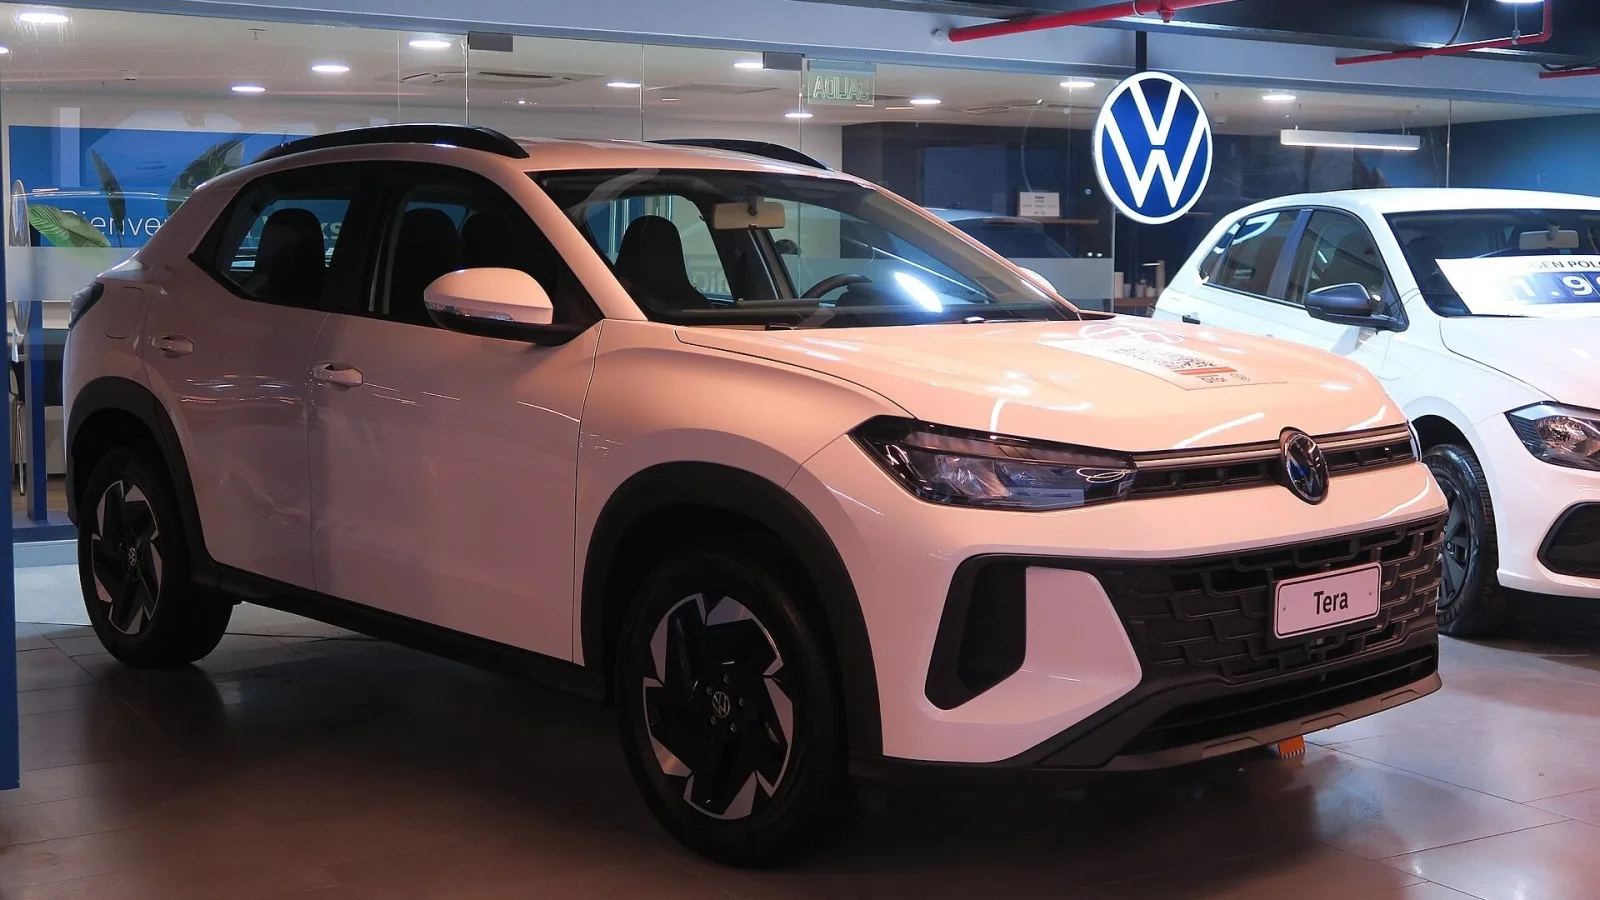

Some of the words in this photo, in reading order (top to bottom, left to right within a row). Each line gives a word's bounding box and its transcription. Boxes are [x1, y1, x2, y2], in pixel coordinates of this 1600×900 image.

[1098, 76, 1210, 214] VW
[62, 209, 168, 236] enve
[1313, 590, 1348, 614] Tera
